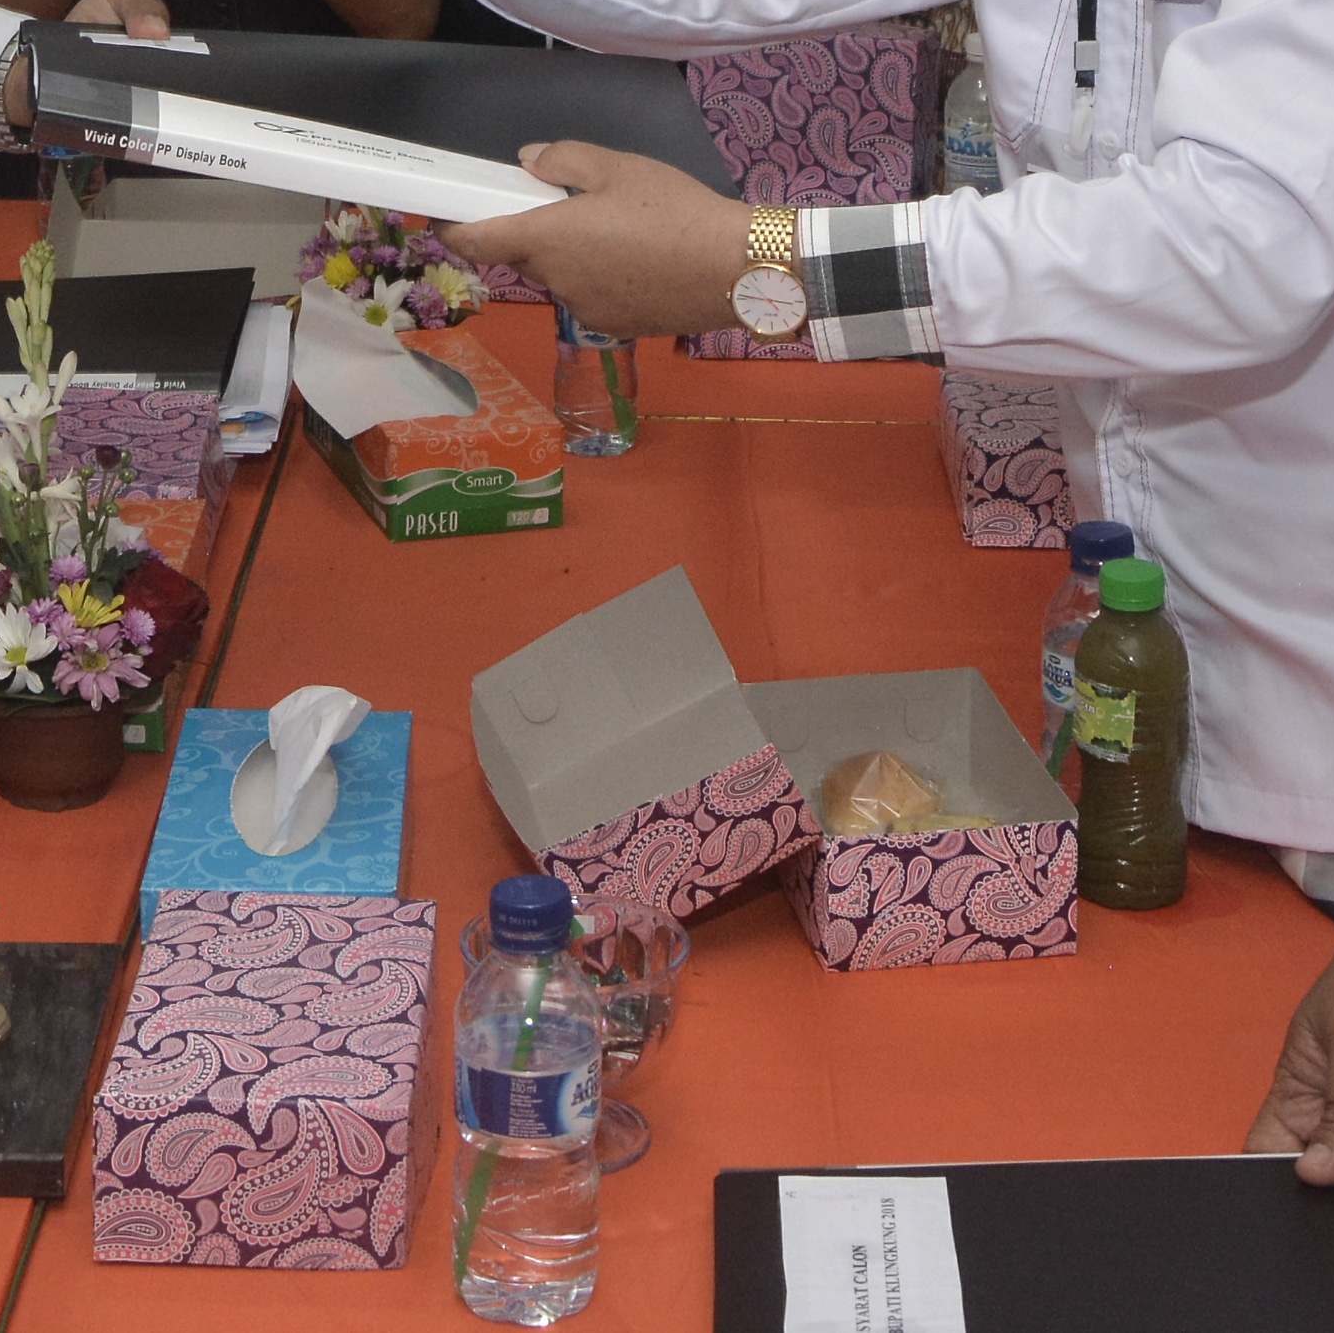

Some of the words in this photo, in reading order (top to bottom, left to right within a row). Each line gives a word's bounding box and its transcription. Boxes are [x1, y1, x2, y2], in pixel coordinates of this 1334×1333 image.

[84, 129, 116, 147] Vivid
[119, 135, 154, 153] Color
[156, 143, 172, 155] PP
[175, 146, 216, 167] Display
[219, 154, 247, 170] Book
[163, 380, 186, 389] Vivid
[466, 472, 503, 488] Smart
[405, 509, 458, 536] PASEO
[510, 1083, 526, 1094] 330
[880, 1197, 895, 1220] 2018
[852, 1244, 867, 1285] CALON
[882, 1220, 901, 1294] KLUNGKUNG
